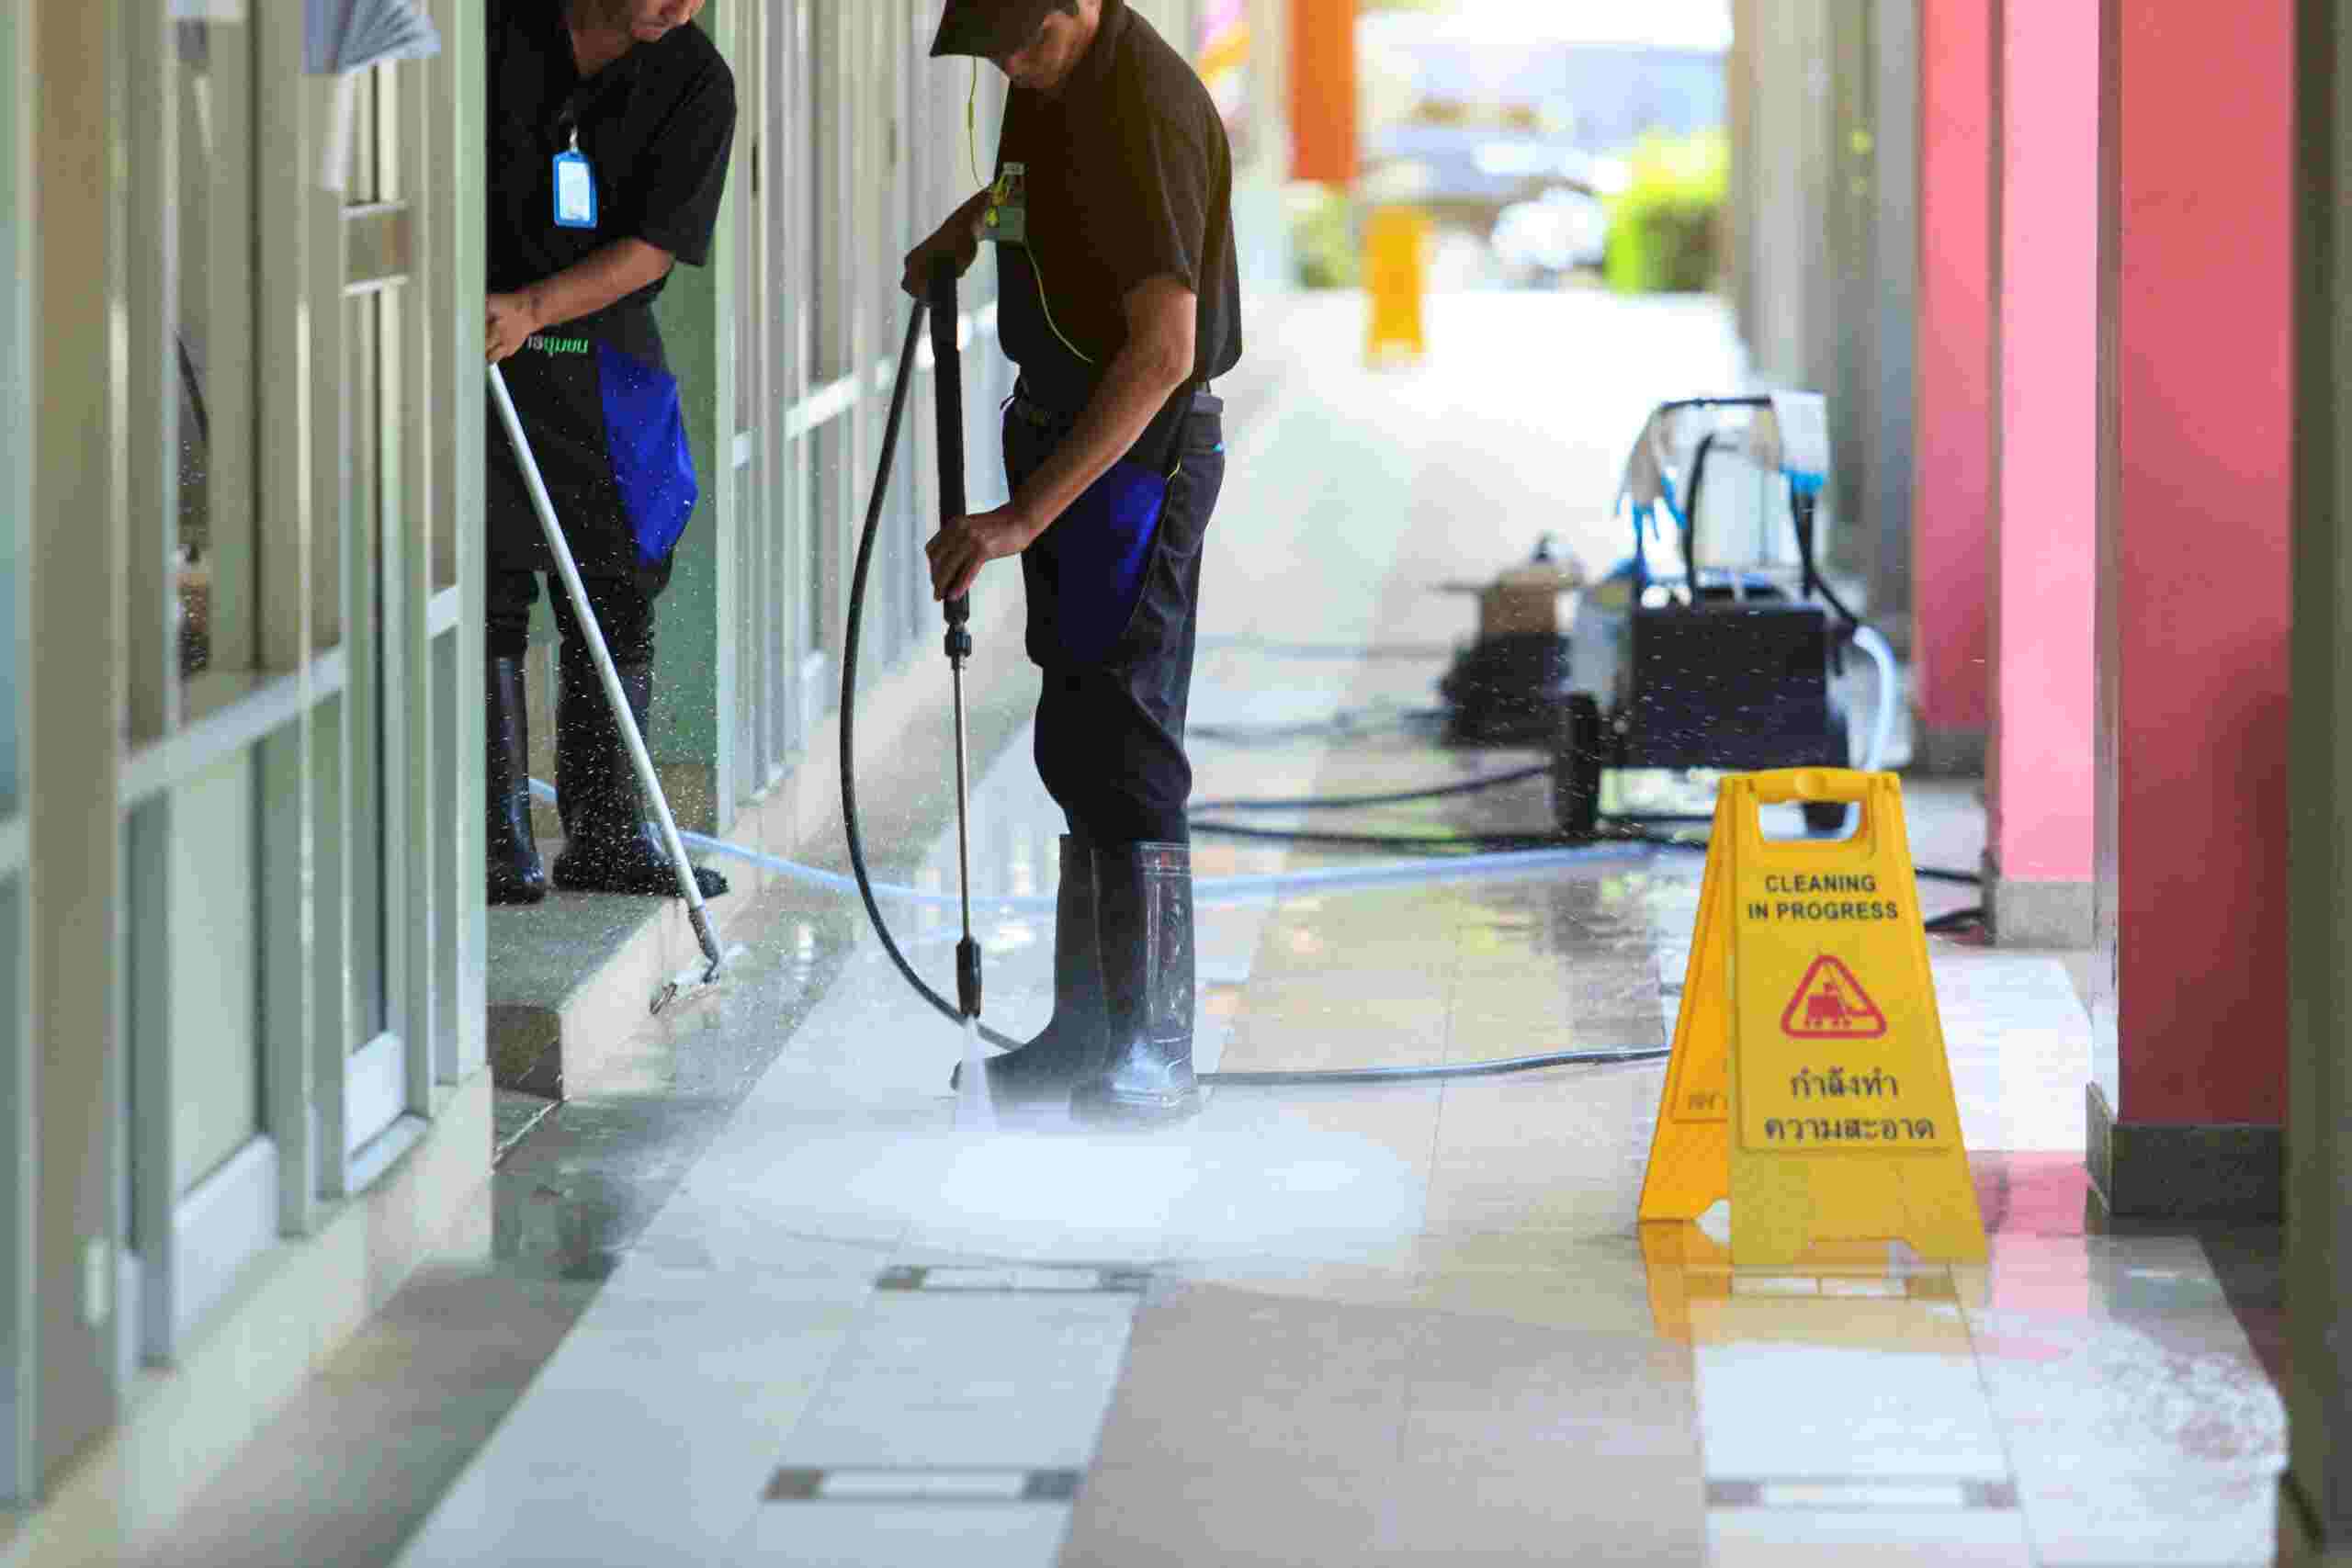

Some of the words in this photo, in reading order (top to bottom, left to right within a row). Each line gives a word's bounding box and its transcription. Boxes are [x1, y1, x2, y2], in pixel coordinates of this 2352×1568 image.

[1765, 874, 1876, 893] CLEANING
[1748, 902, 1769, 919] IN
[1777, 902, 1898, 919] PROGRESS
[1764, 1117, 1935, 1141] ความสะอาด
